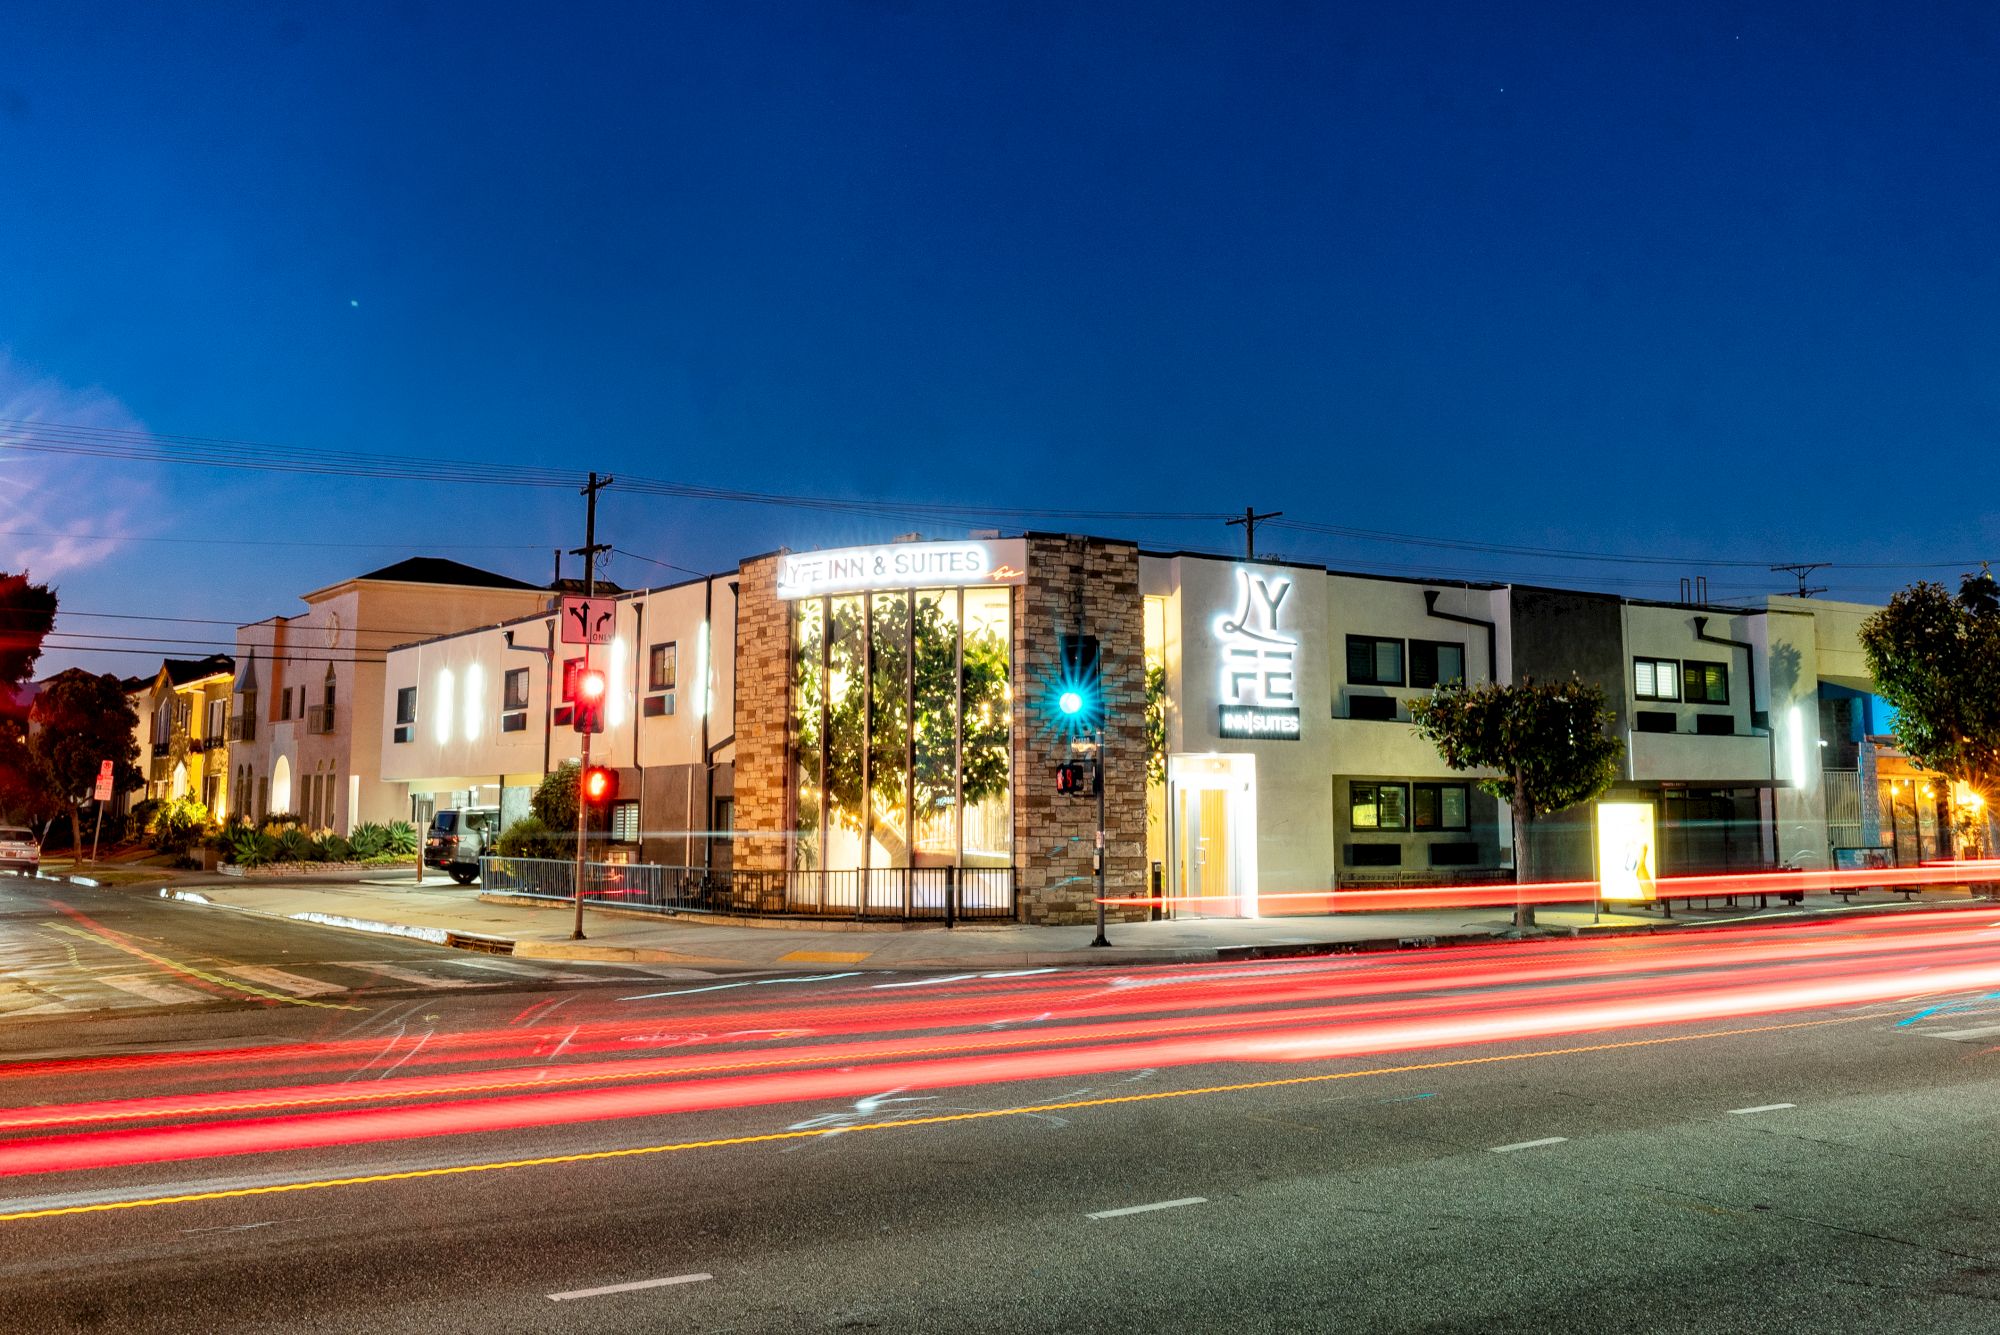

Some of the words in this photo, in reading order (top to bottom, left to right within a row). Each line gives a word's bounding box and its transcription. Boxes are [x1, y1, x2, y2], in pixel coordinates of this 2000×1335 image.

[828, 557, 864, 580] INN
[873, 556, 887, 575] &
[895, 551, 980, 574] SUITES
[592, 633, 613, 641] ONLY
